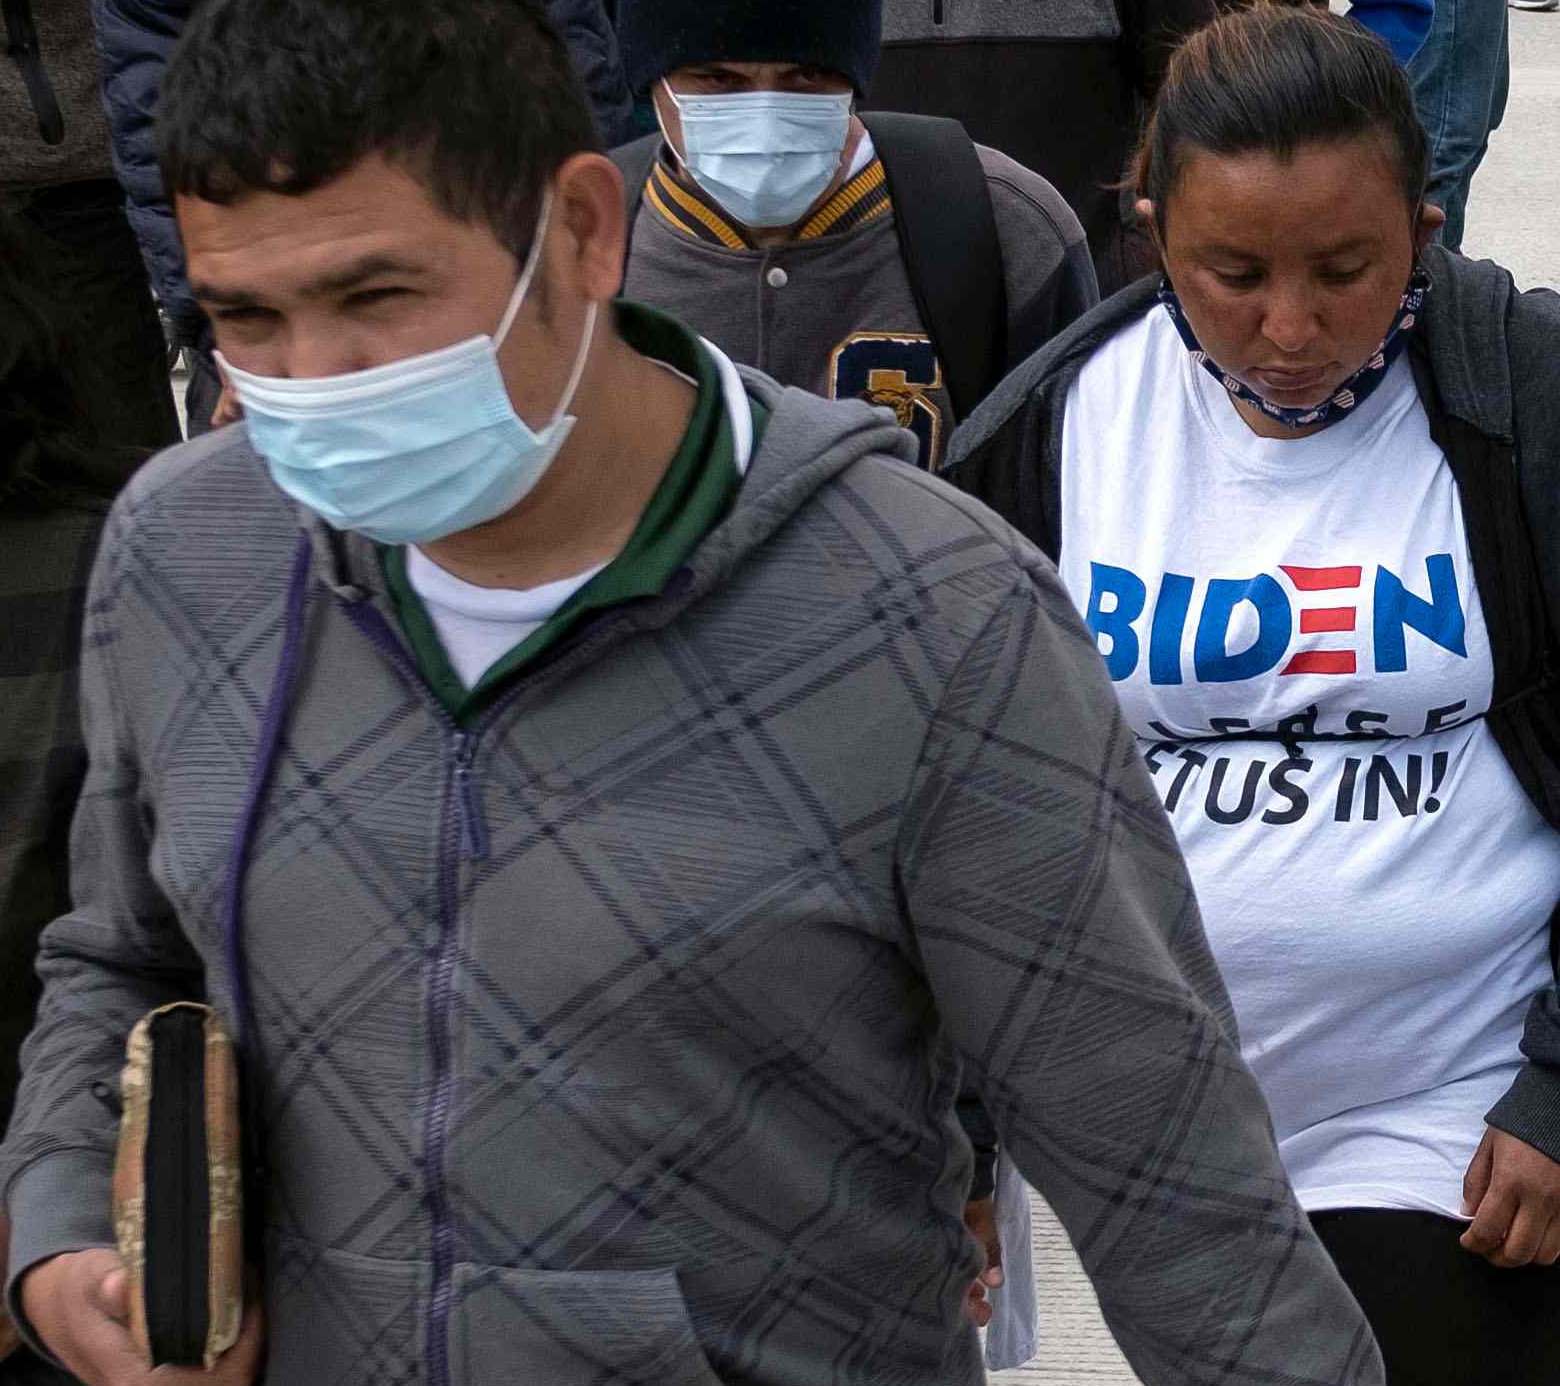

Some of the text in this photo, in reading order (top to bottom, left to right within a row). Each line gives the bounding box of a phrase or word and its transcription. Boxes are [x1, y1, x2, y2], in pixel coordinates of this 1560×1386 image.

[1086, 552, 1469, 686] BIDEN
[1203, 756, 1314, 825] US
[1334, 750, 1450, 823] IN!
